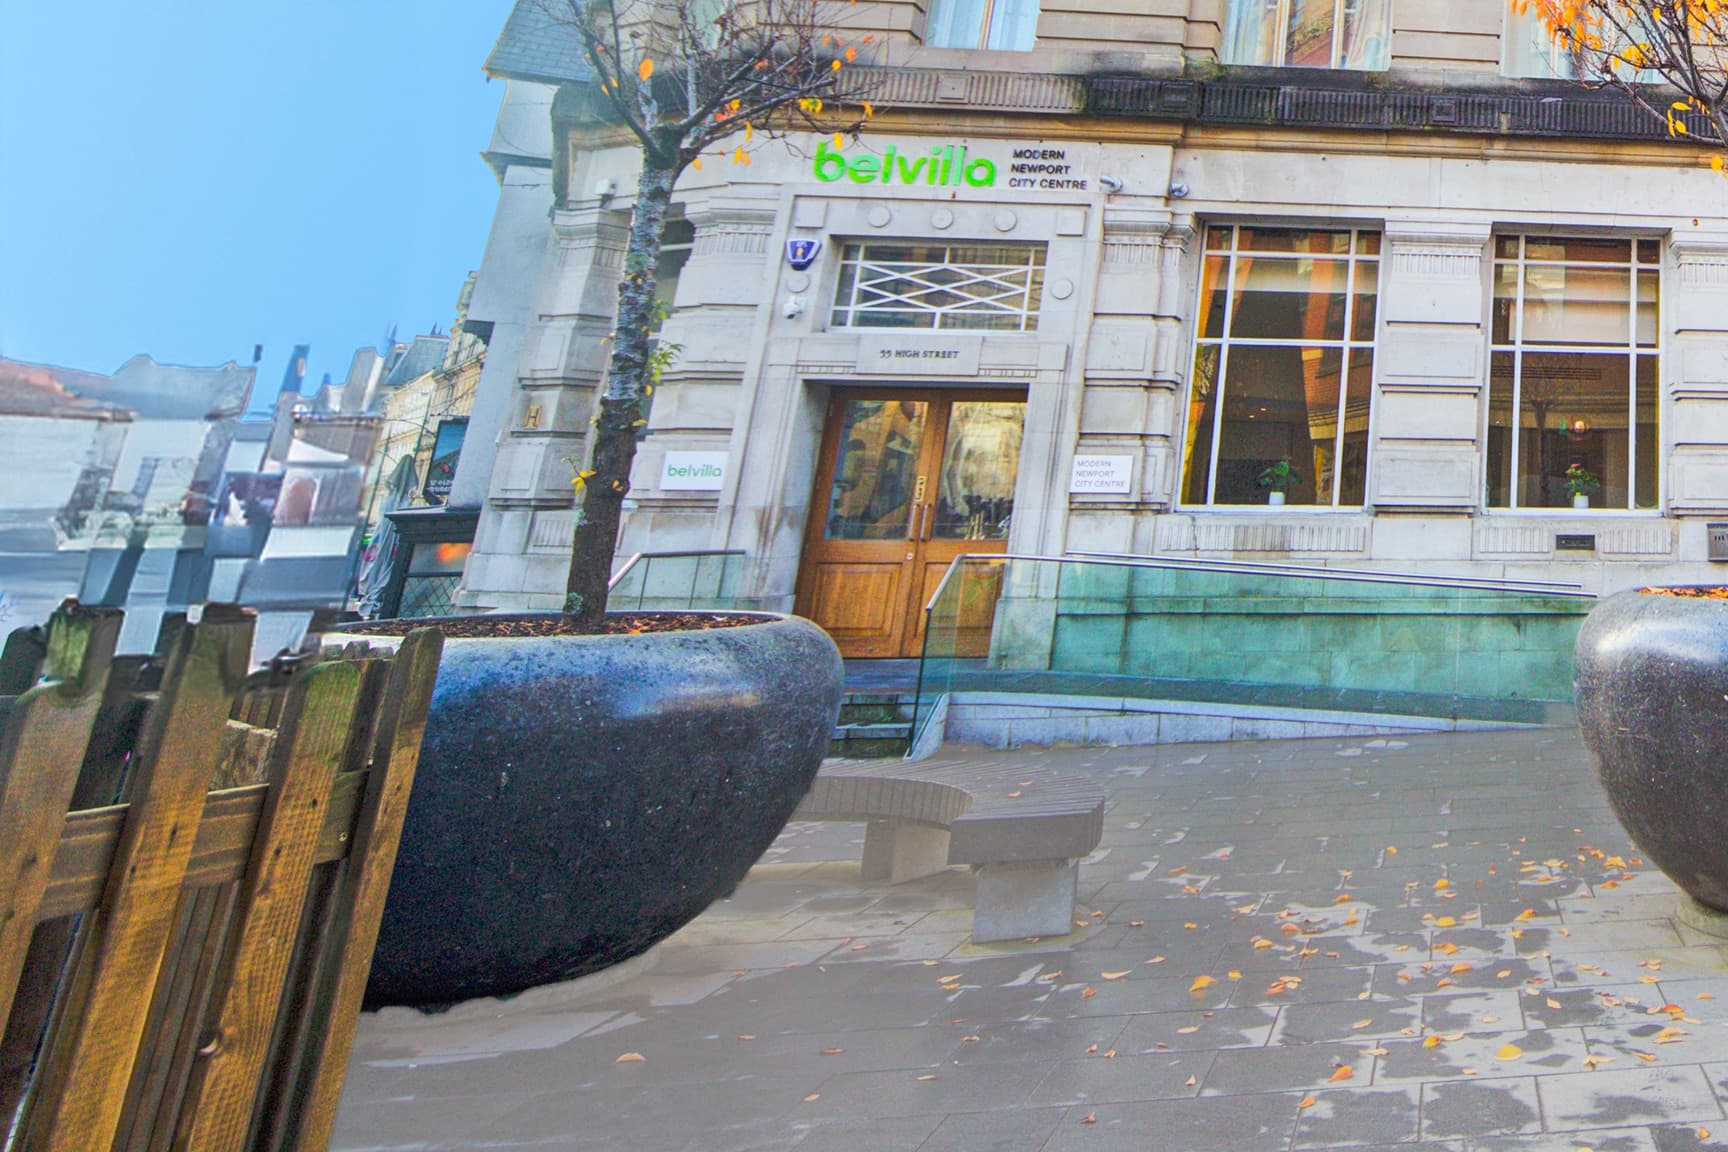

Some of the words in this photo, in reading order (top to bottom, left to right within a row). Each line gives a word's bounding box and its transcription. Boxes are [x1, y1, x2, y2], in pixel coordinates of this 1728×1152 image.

[1012, 149, 1066, 160] MODERN
[813, 141, 997, 187] belvilla
[1010, 163, 1071, 175] NEWPORT
[1008, 177, 1037, 188] CITY
[1039, 178, 1088, 190] CENTRE
[895, 350, 920, 359] HIGH
[922, 350, 960, 359] STREET
[667, 464, 722, 477] belvilla
[1075, 470, 1115, 478] NEWPORT
[1074, 480, 1092, 488] CITY
[1094, 480, 1126, 488] CENTRE
